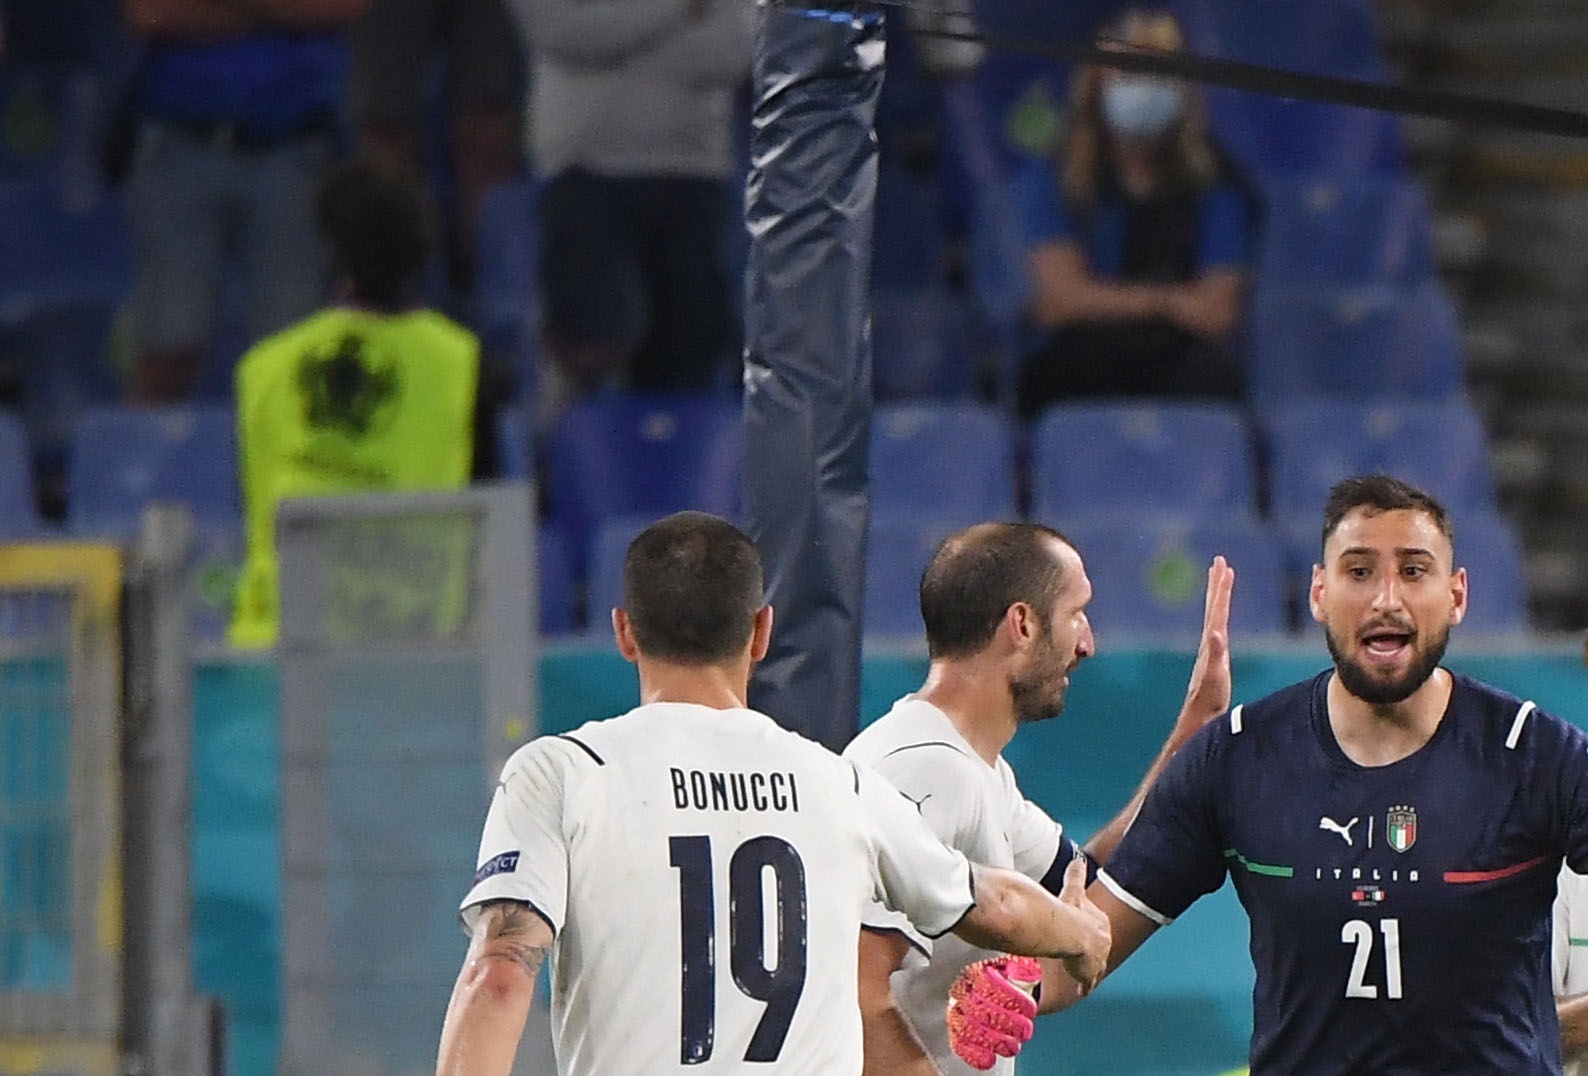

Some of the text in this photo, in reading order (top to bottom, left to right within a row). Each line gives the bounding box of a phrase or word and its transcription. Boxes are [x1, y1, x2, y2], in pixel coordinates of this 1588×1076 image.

[670, 767, 798, 812] BONUCCI
[1316, 868, 1419, 882] ITALIA
[669, 835, 808, 1066] 19
[1341, 918, 1403, 999] 21
